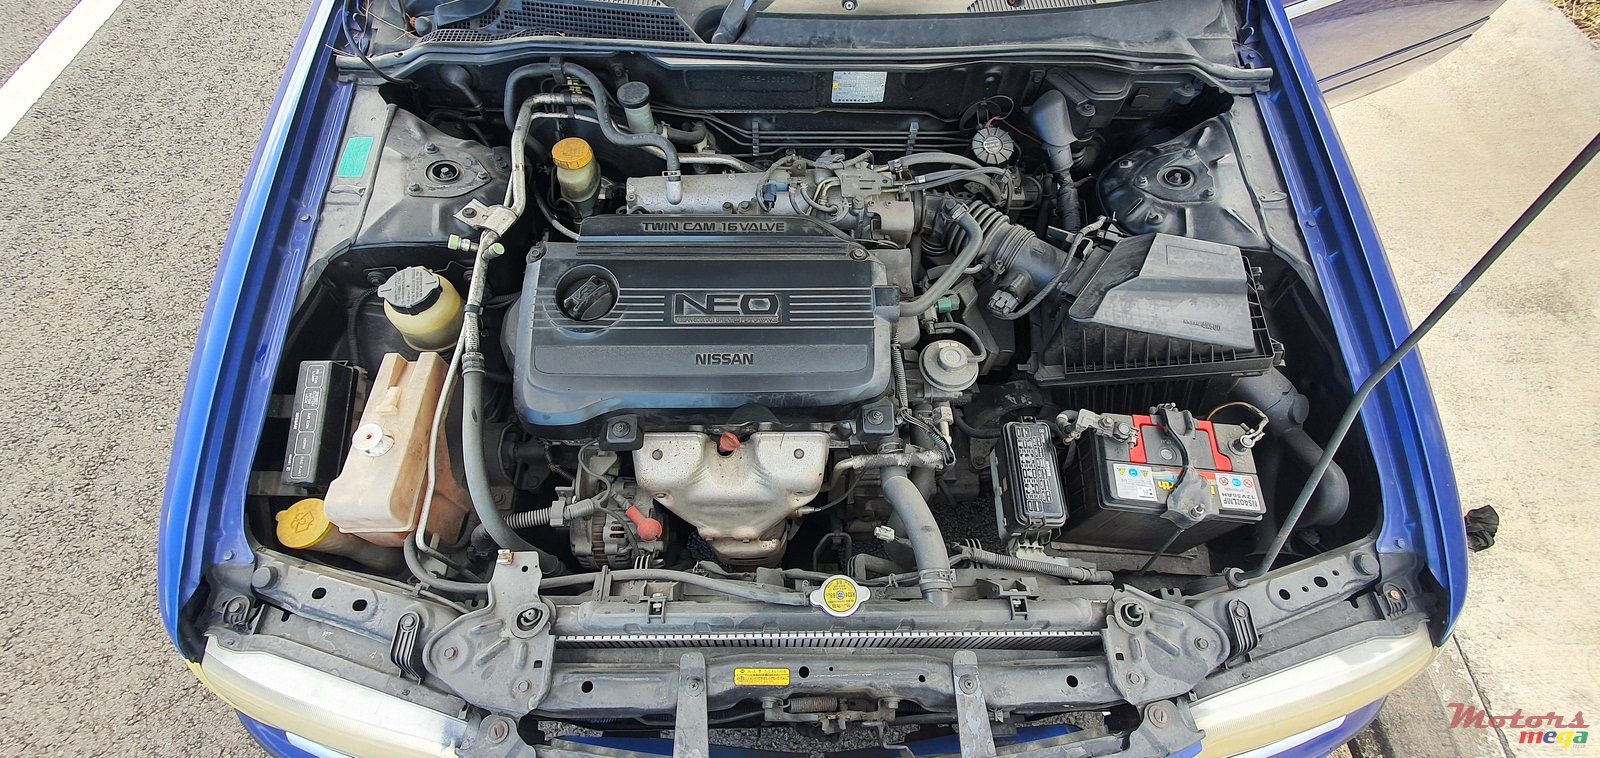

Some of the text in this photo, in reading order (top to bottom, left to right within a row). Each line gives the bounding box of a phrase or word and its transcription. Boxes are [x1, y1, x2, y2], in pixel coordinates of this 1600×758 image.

[642, 222, 785, 231] TWIN CAM 16 VALVE
[674, 293, 780, 316] NEO
[695, 353, 754, 365] NISSAN
